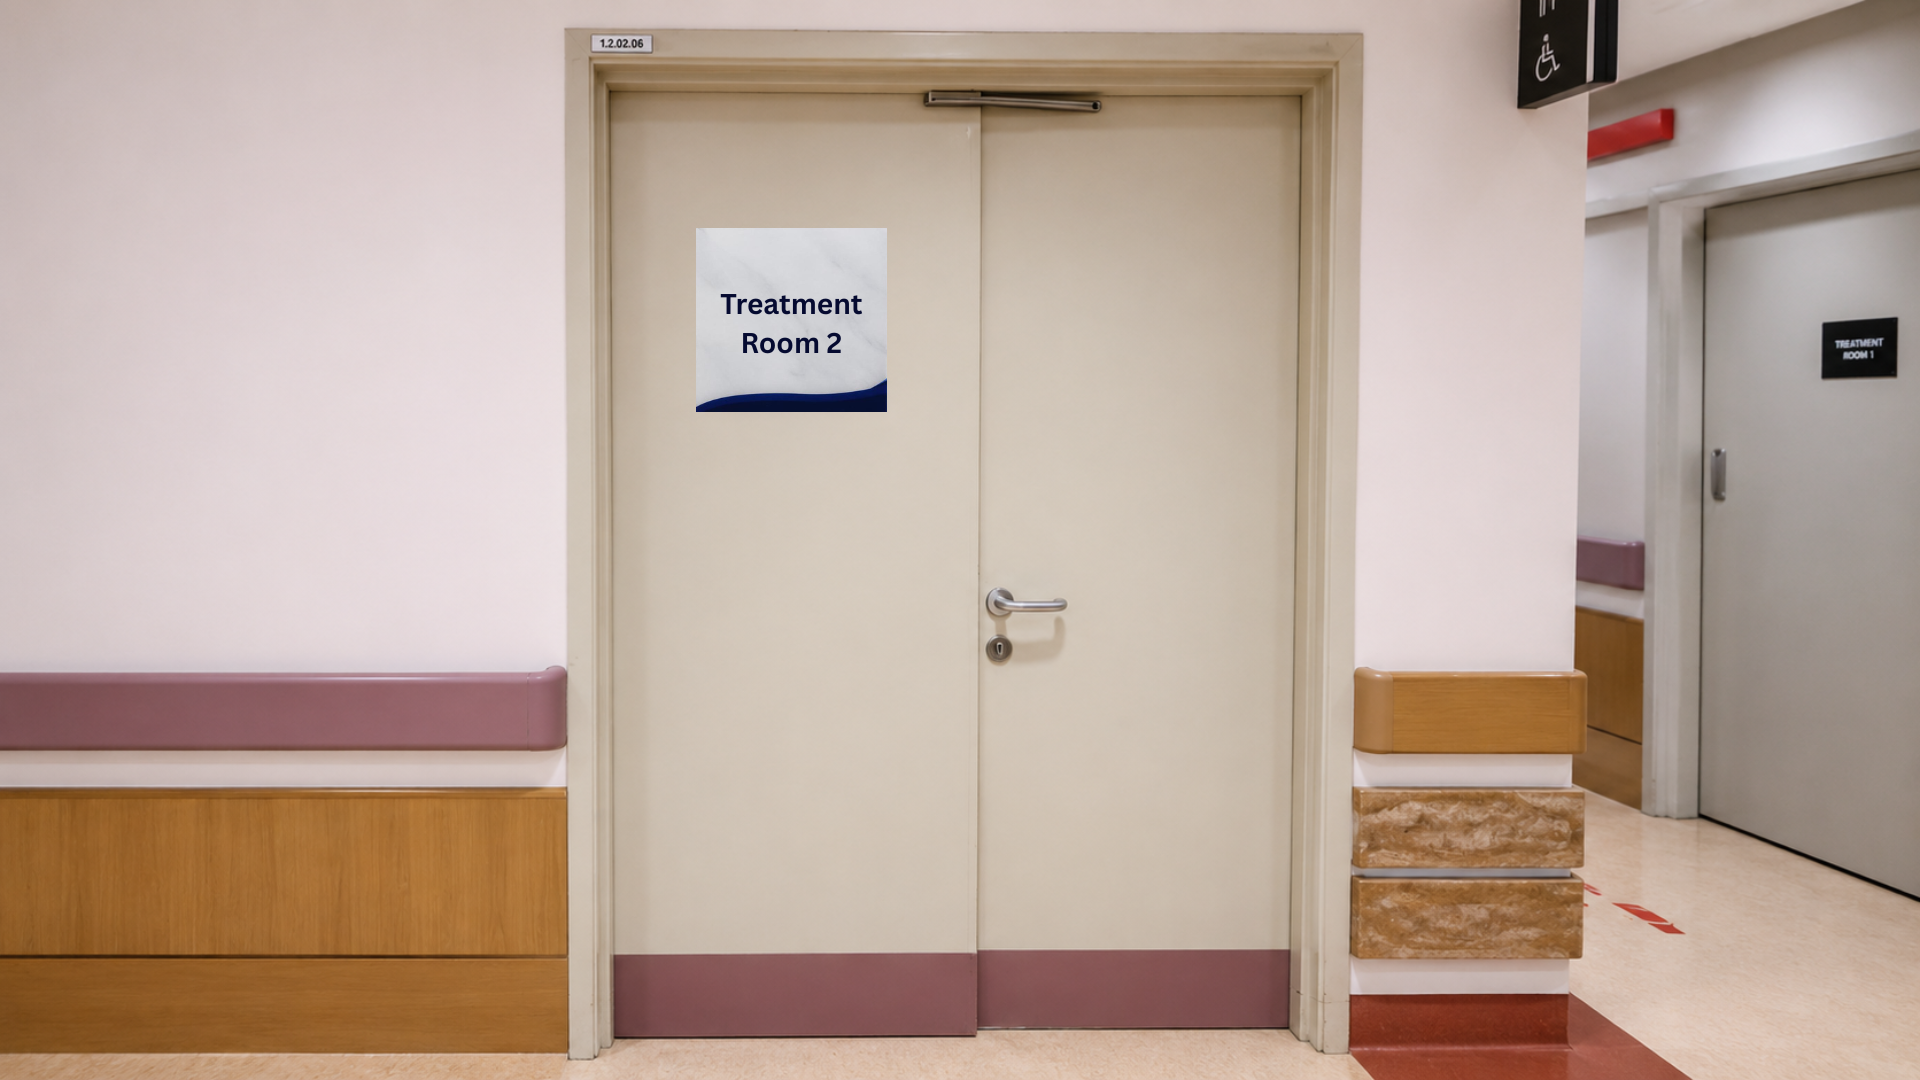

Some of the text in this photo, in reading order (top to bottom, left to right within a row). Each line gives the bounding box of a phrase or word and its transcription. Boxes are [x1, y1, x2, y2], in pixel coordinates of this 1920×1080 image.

[600, 38, 644, 48] 1.2.02.06
[720, 293, 863, 315] Treatment
[742, 332, 842, 354] Room 2
[1834, 337, 1884, 348] TREATMENT
[1843, 350, 1875, 359] ROOM 1
